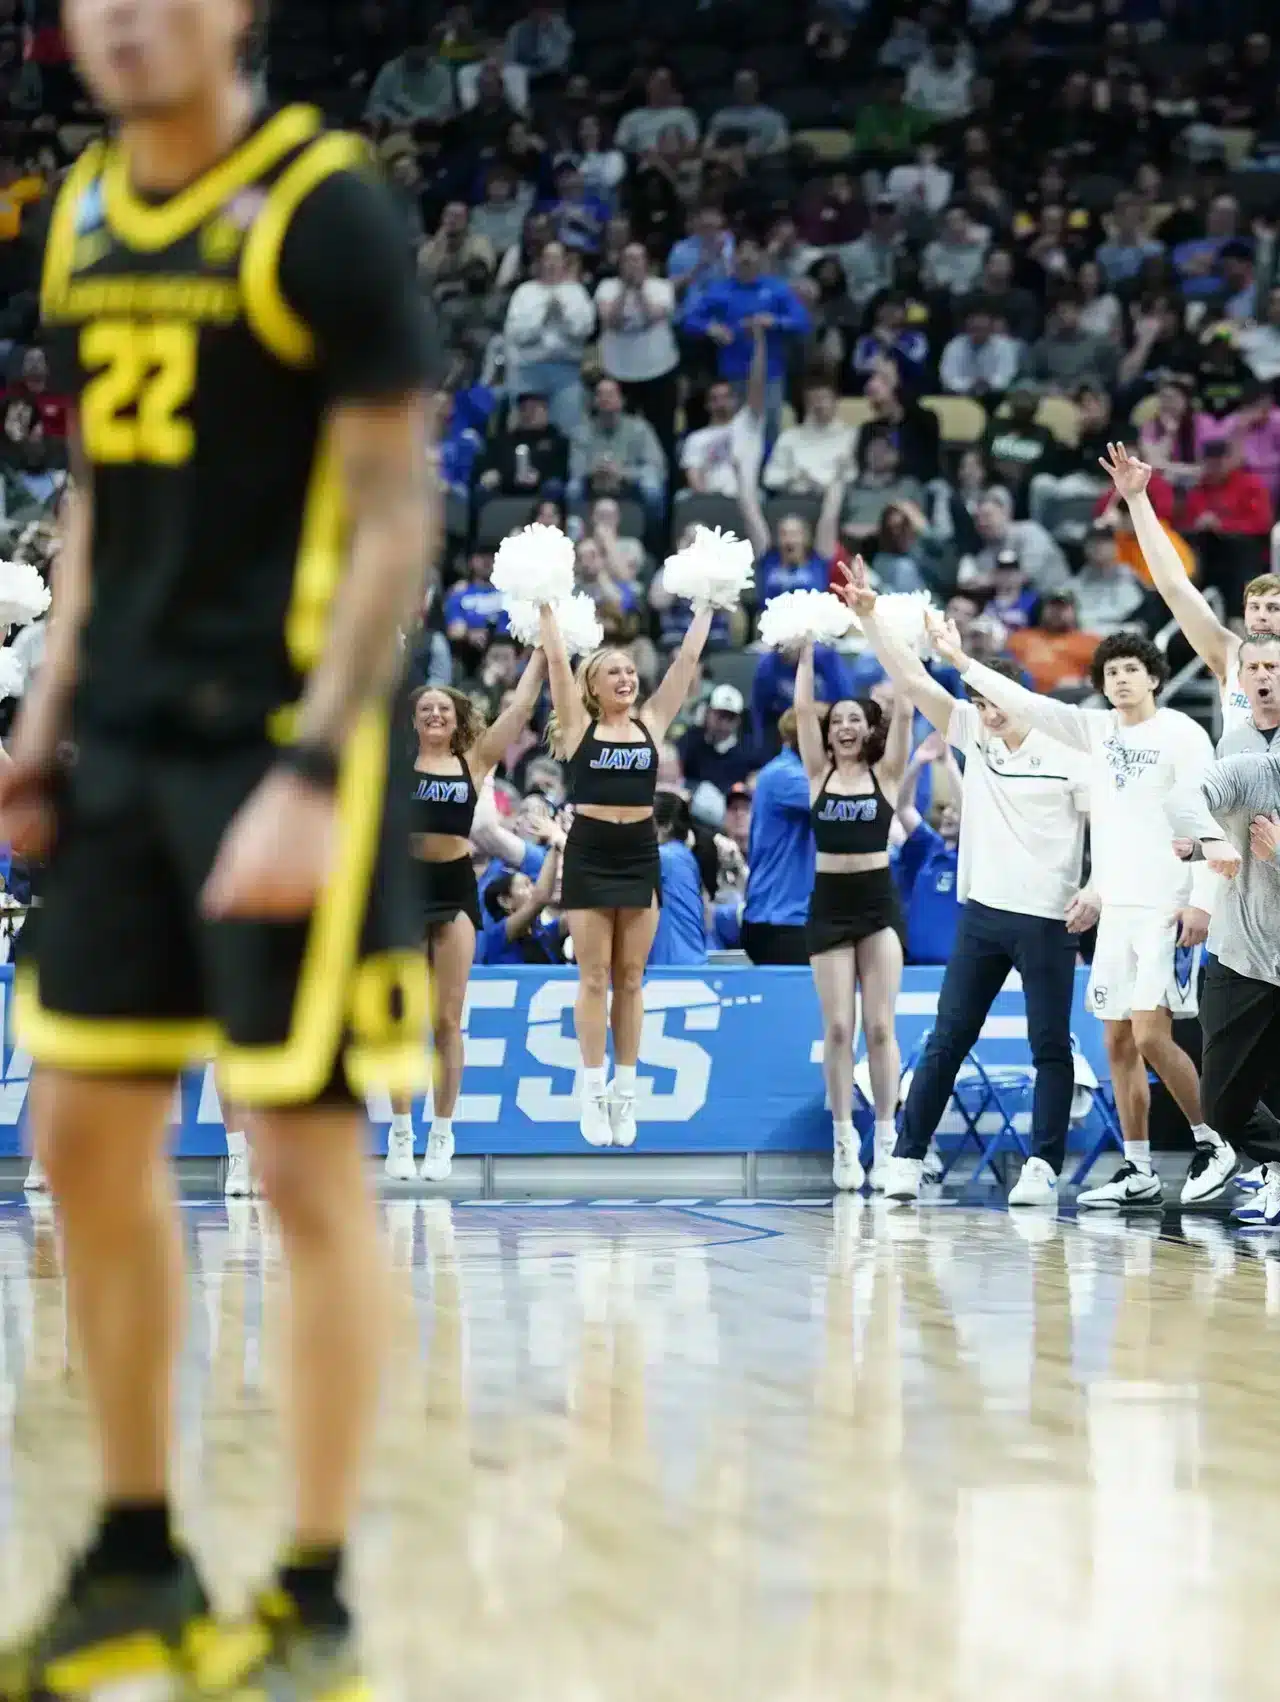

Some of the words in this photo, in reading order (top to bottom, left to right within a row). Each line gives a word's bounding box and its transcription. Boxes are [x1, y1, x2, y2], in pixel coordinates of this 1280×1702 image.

[79, 318, 198, 465] 22
[1229, 692, 1252, 710] CRE
[588, 747, 651, 770] JAYS
[817, 798, 878, 821] JAYS
[366, 979, 721, 1122] ESS
